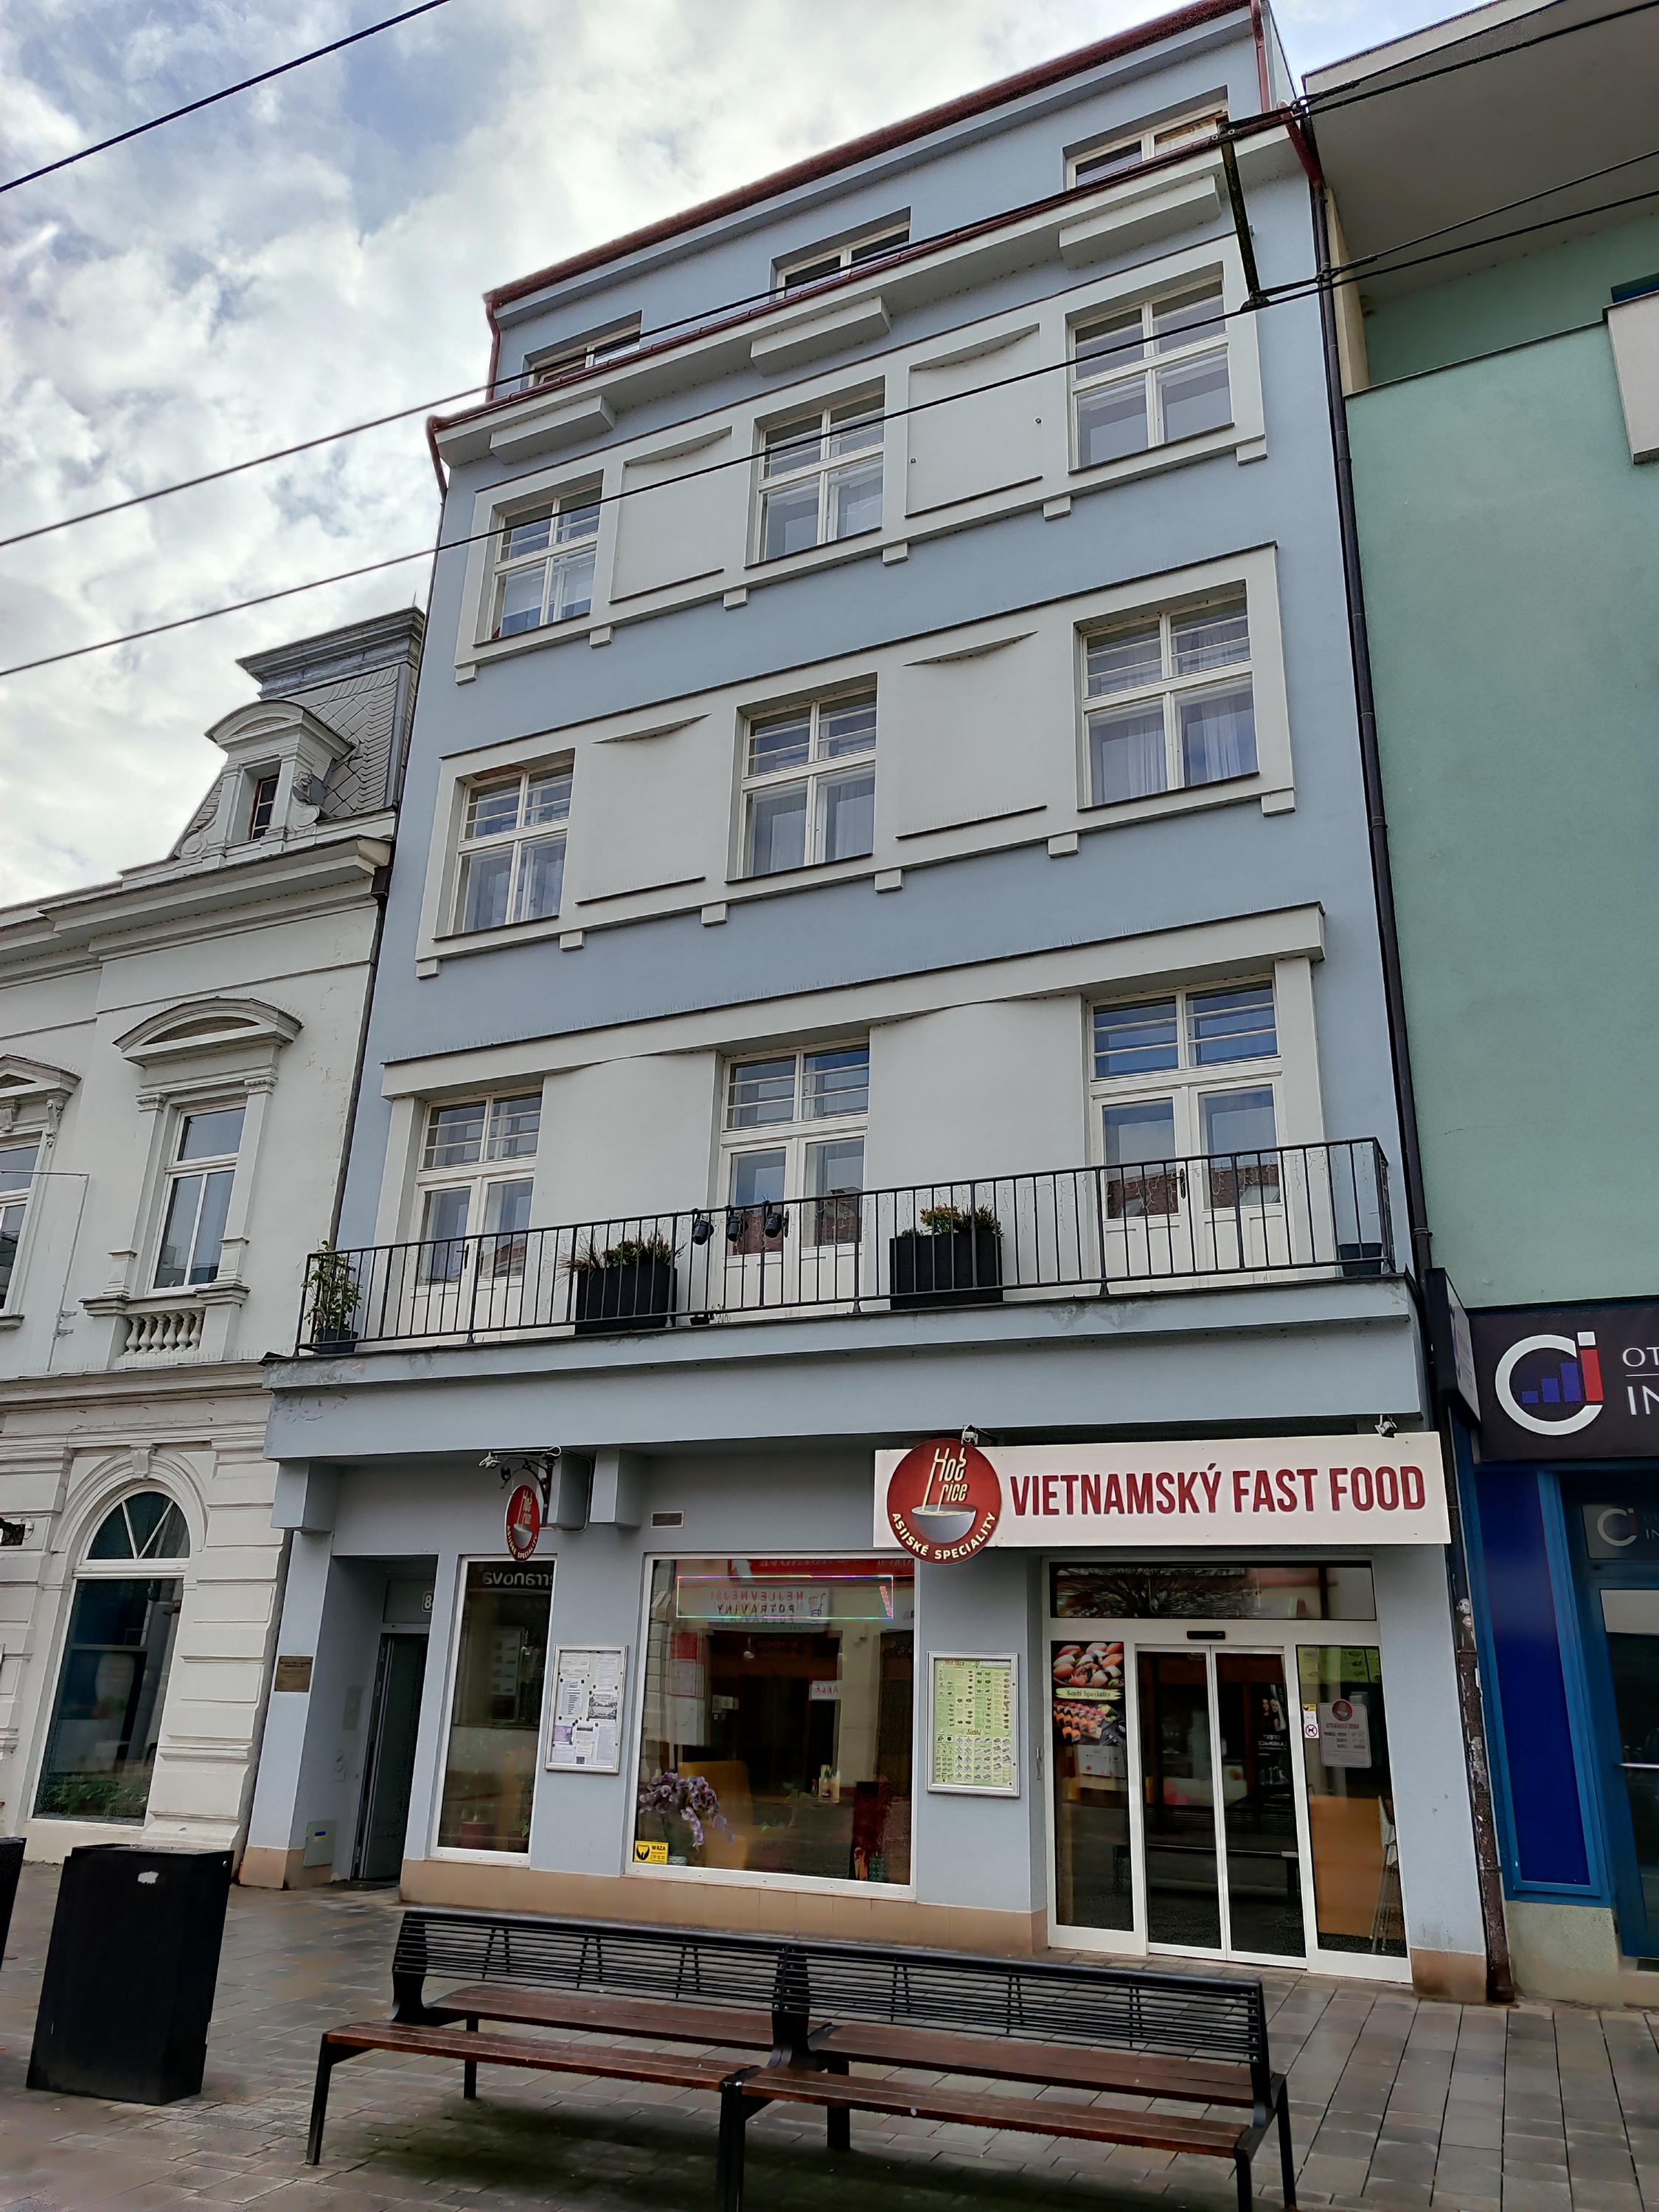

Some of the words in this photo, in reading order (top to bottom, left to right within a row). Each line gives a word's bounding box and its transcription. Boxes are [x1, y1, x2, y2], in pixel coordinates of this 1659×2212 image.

[937, 1481, 967, 1512] rice
[1010, 1463, 1222, 1516] VIETNAMSKÝ
[1232, 1469, 1318, 1512] FAST
[1329, 1466, 1425, 1511] FOOD
[891, 1513, 930, 1556] ASIJSKÉ
[934, 1512, 996, 1559] SPECIALITY
